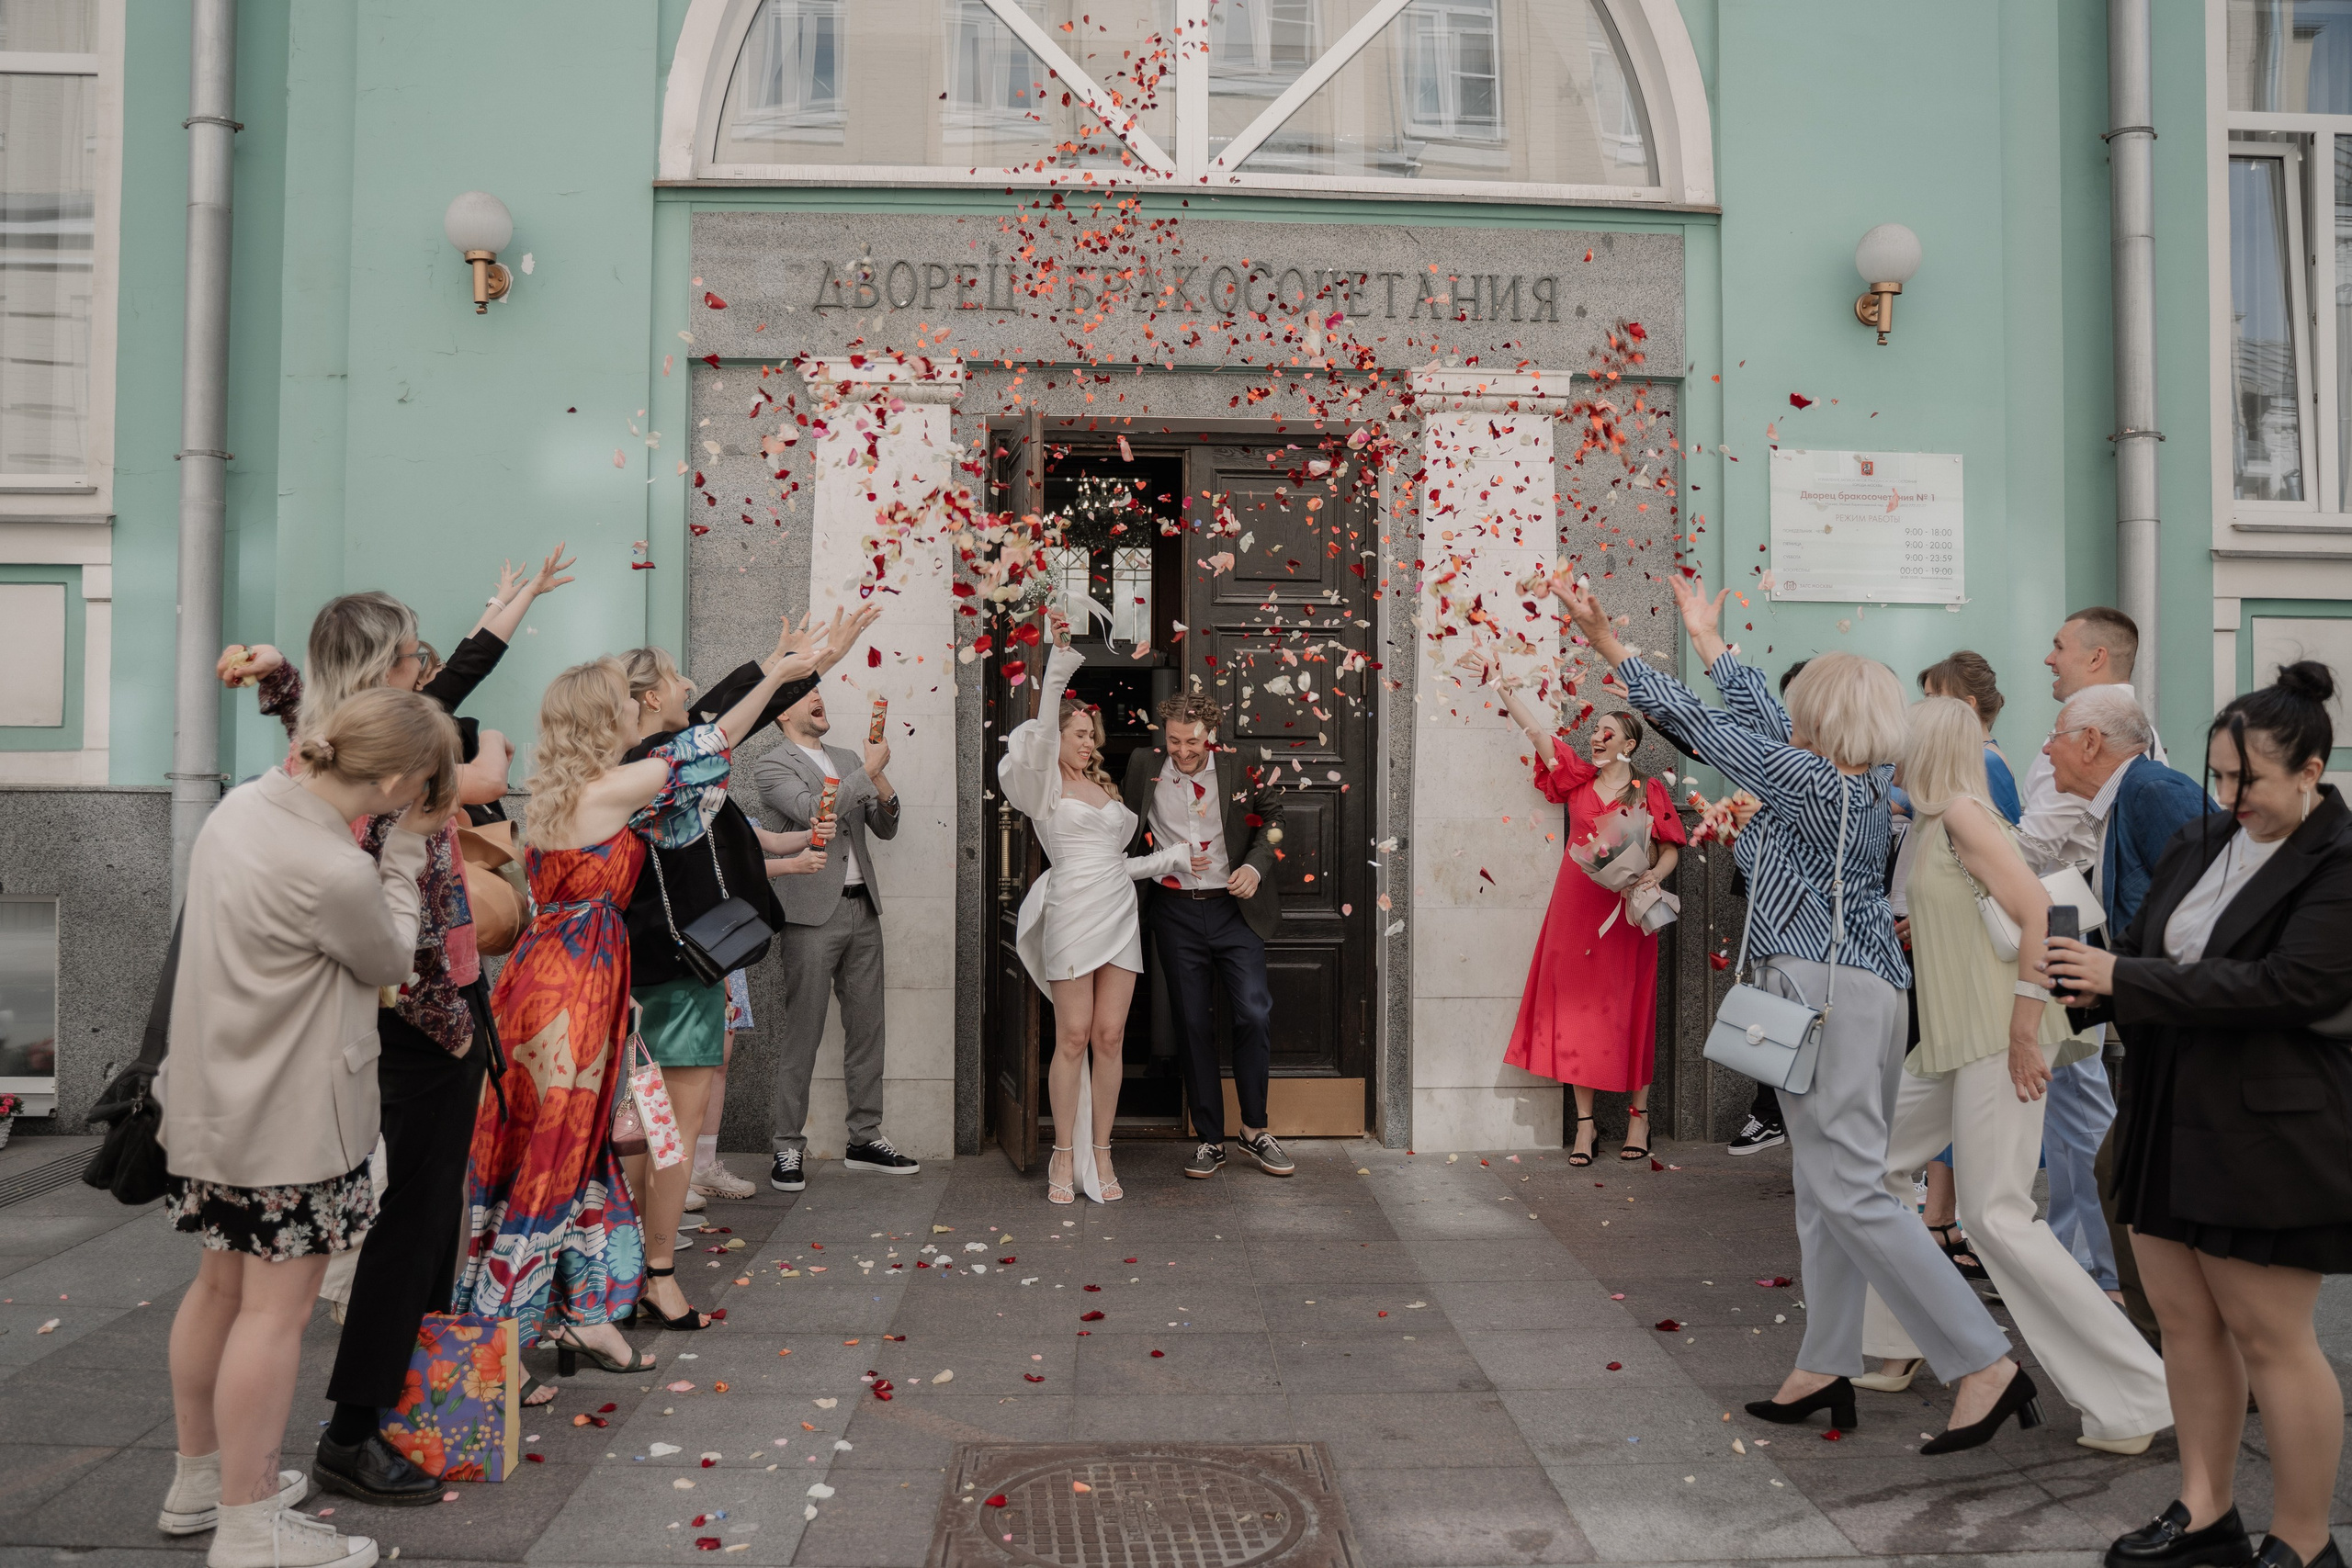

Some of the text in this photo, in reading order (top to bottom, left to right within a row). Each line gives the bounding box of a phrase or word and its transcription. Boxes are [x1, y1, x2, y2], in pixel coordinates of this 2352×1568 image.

[812, 259, 1560, 321] ДВОРЕЦ БРАКОСОЧЕТАНИЯ
[1800, 491, 1836, 502] Дворец
[1838, 491, 1914, 502] бракосочетния
[1930, 493, 1935, 502] 1
[1836, 514, 1901, 524] РЕЖИМ РАБОТЫ
[1931, 528, 1952, 536] 18:00
[1929, 541, 1952, 549] 20:00
[1929, 554, 1952, 562] 23:59
[1931, 567, 1952, 575] 19:00
